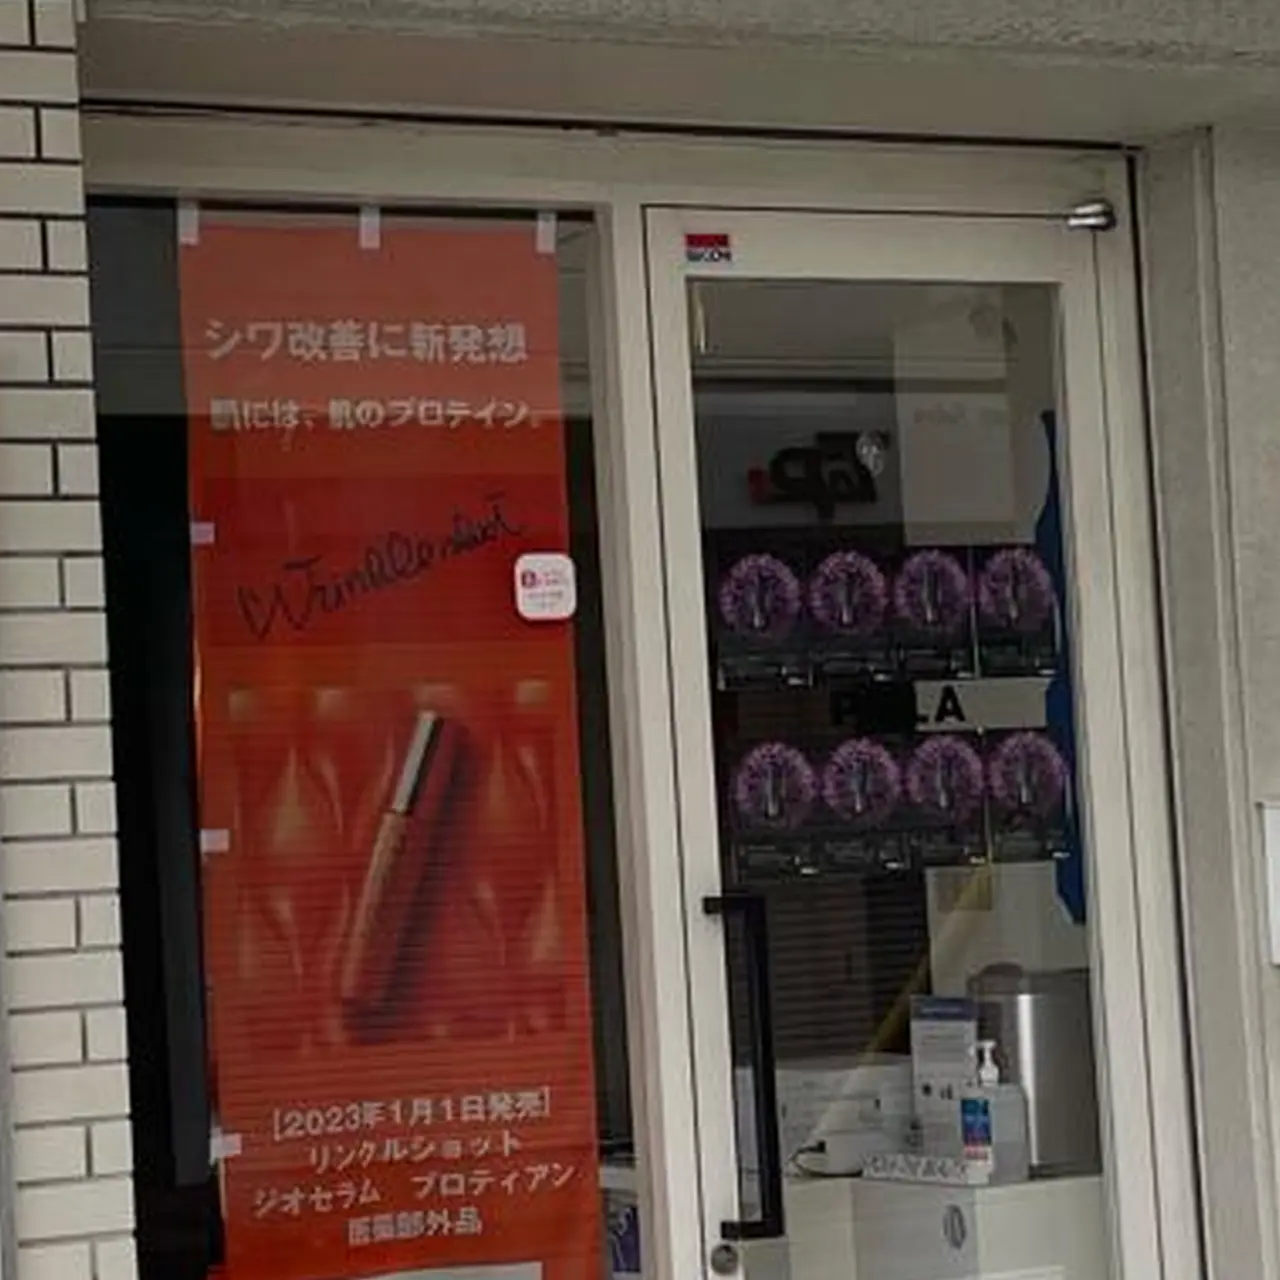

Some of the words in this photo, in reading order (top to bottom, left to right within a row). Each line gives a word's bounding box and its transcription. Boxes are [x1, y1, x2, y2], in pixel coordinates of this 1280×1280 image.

[204, 317, 529, 364] シワ改善に新発想
[308, 1131, 522, 1175] リンクルショット
[254, 1177, 382, 1219] ジオセラム
[410, 1162, 576, 1200] プロティアン
